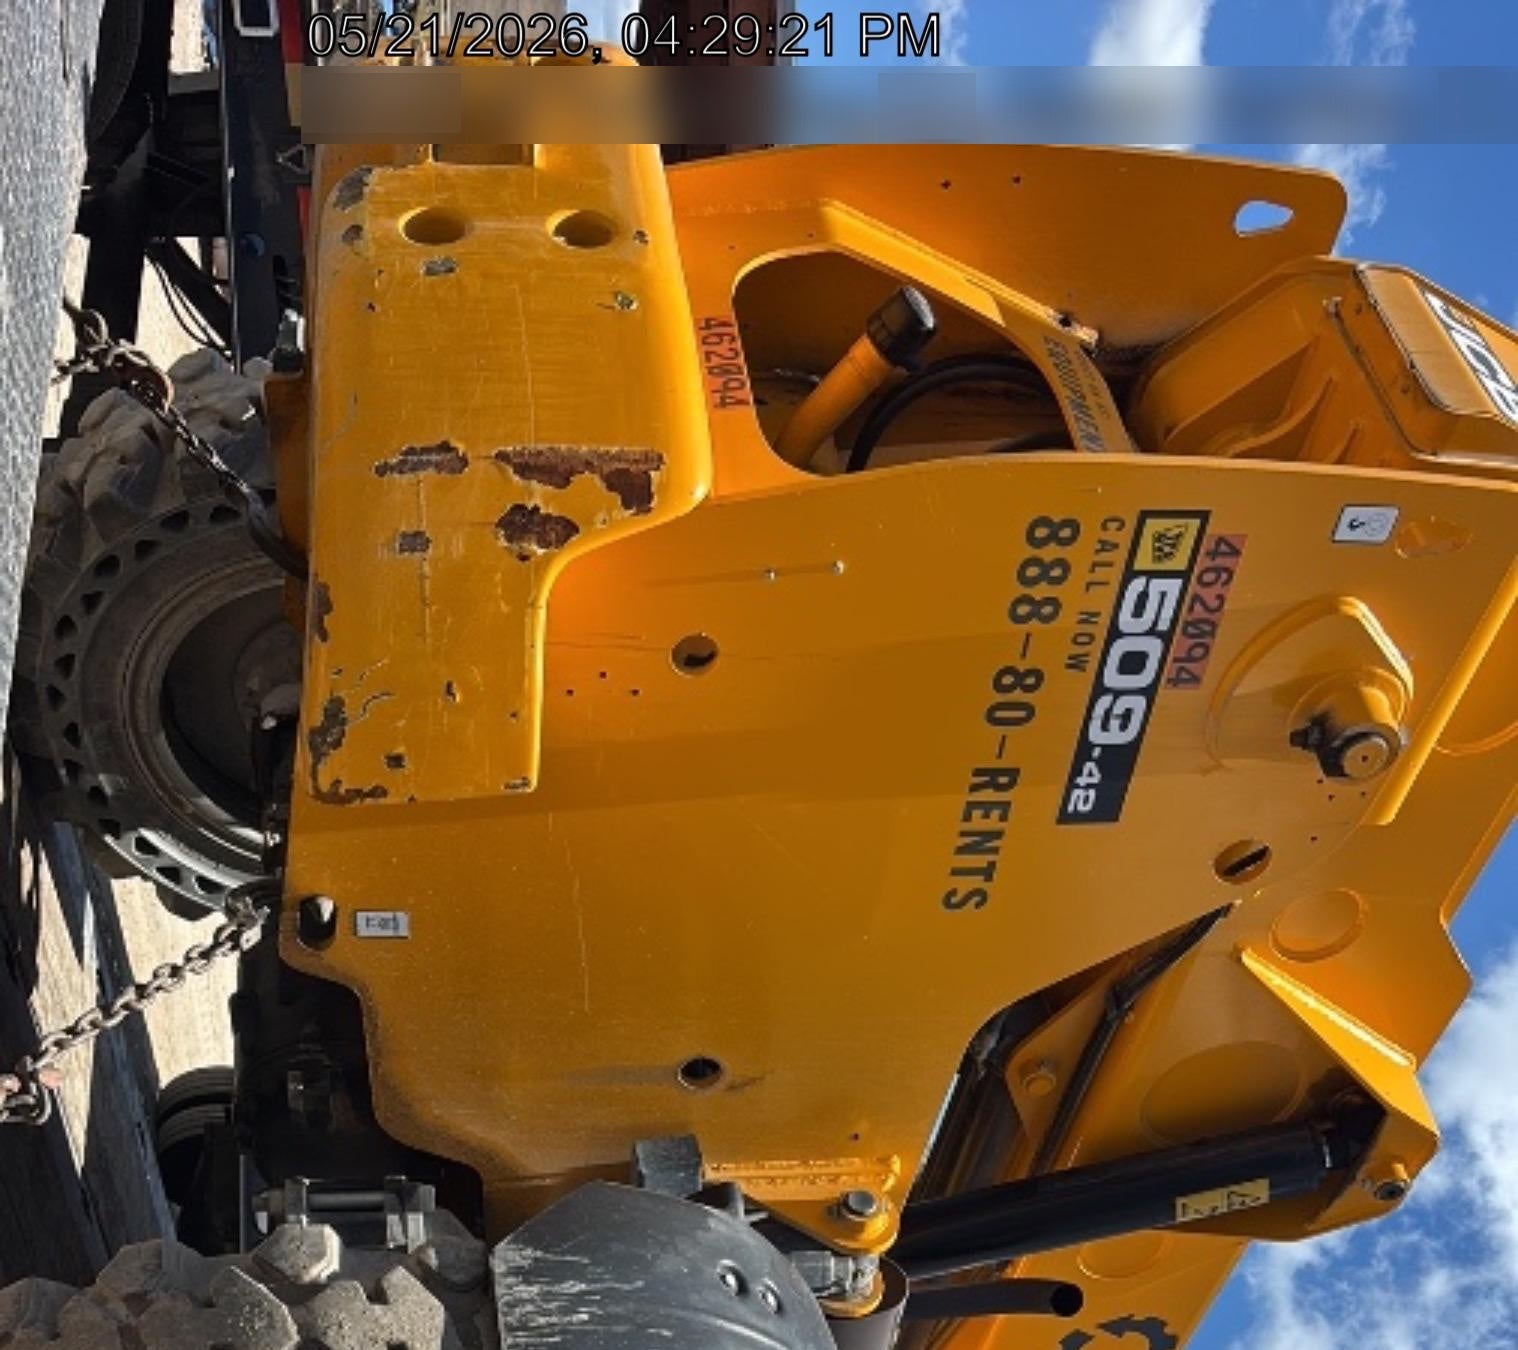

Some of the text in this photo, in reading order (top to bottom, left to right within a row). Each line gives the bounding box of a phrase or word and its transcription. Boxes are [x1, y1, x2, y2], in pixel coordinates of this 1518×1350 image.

[698, 317, 751, 408] 462094
[1065, 516, 1125, 673] CALL NOW
[1167, 535, 1243, 687] 462094
[941, 515, 1081, 911] 888-80-RENTS
[1067, 576, 1185, 813] 509-42
